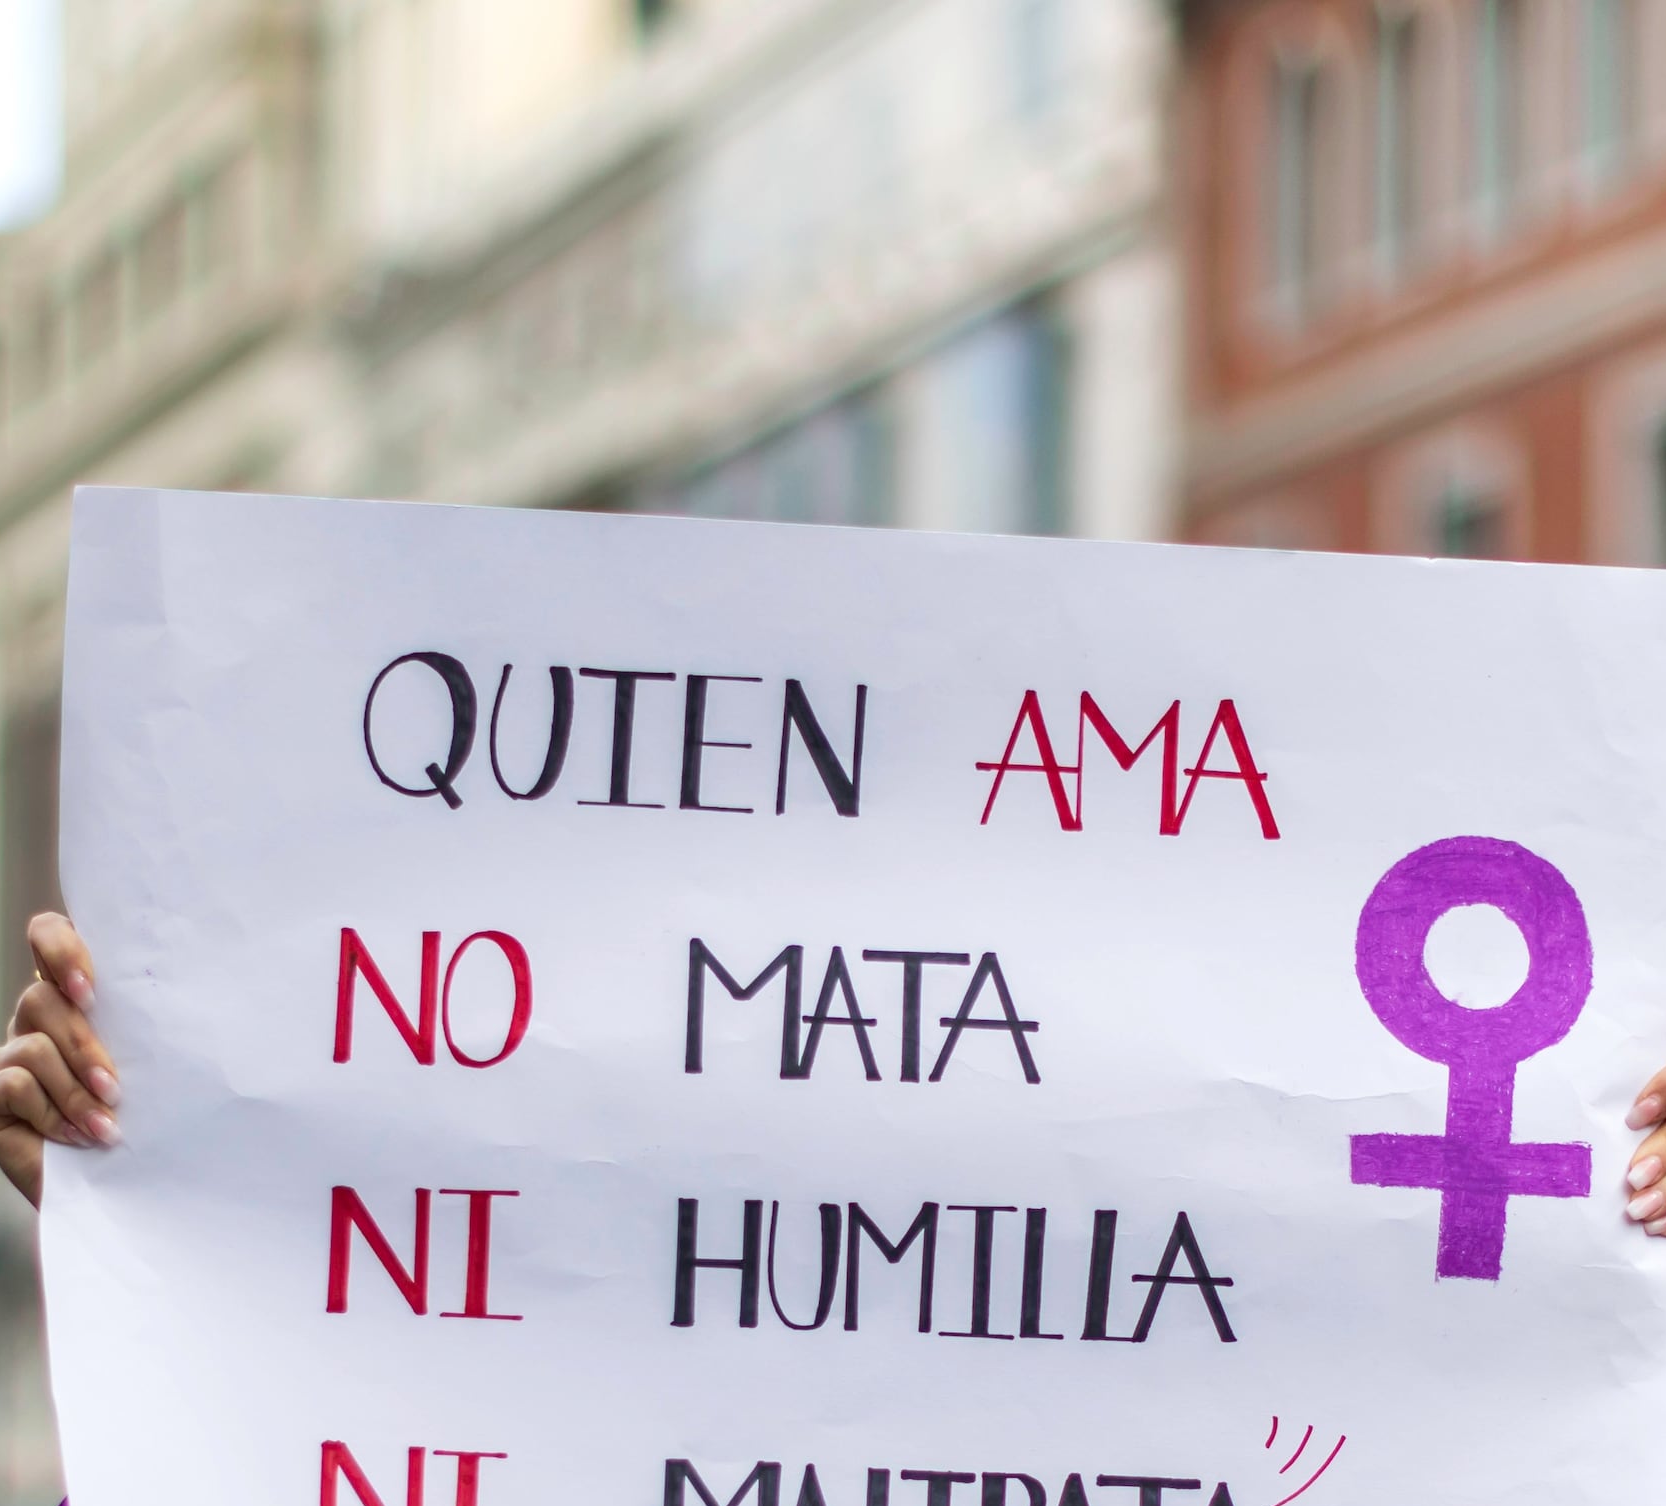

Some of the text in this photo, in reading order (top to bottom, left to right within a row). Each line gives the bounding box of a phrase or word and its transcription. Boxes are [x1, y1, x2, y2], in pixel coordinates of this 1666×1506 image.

[363, 651, 1281, 840] QUIEN AMA
[333, 927, 1040, 1084] NO MATA
[326, 1185, 1237, 1343] NI HUMILLA
